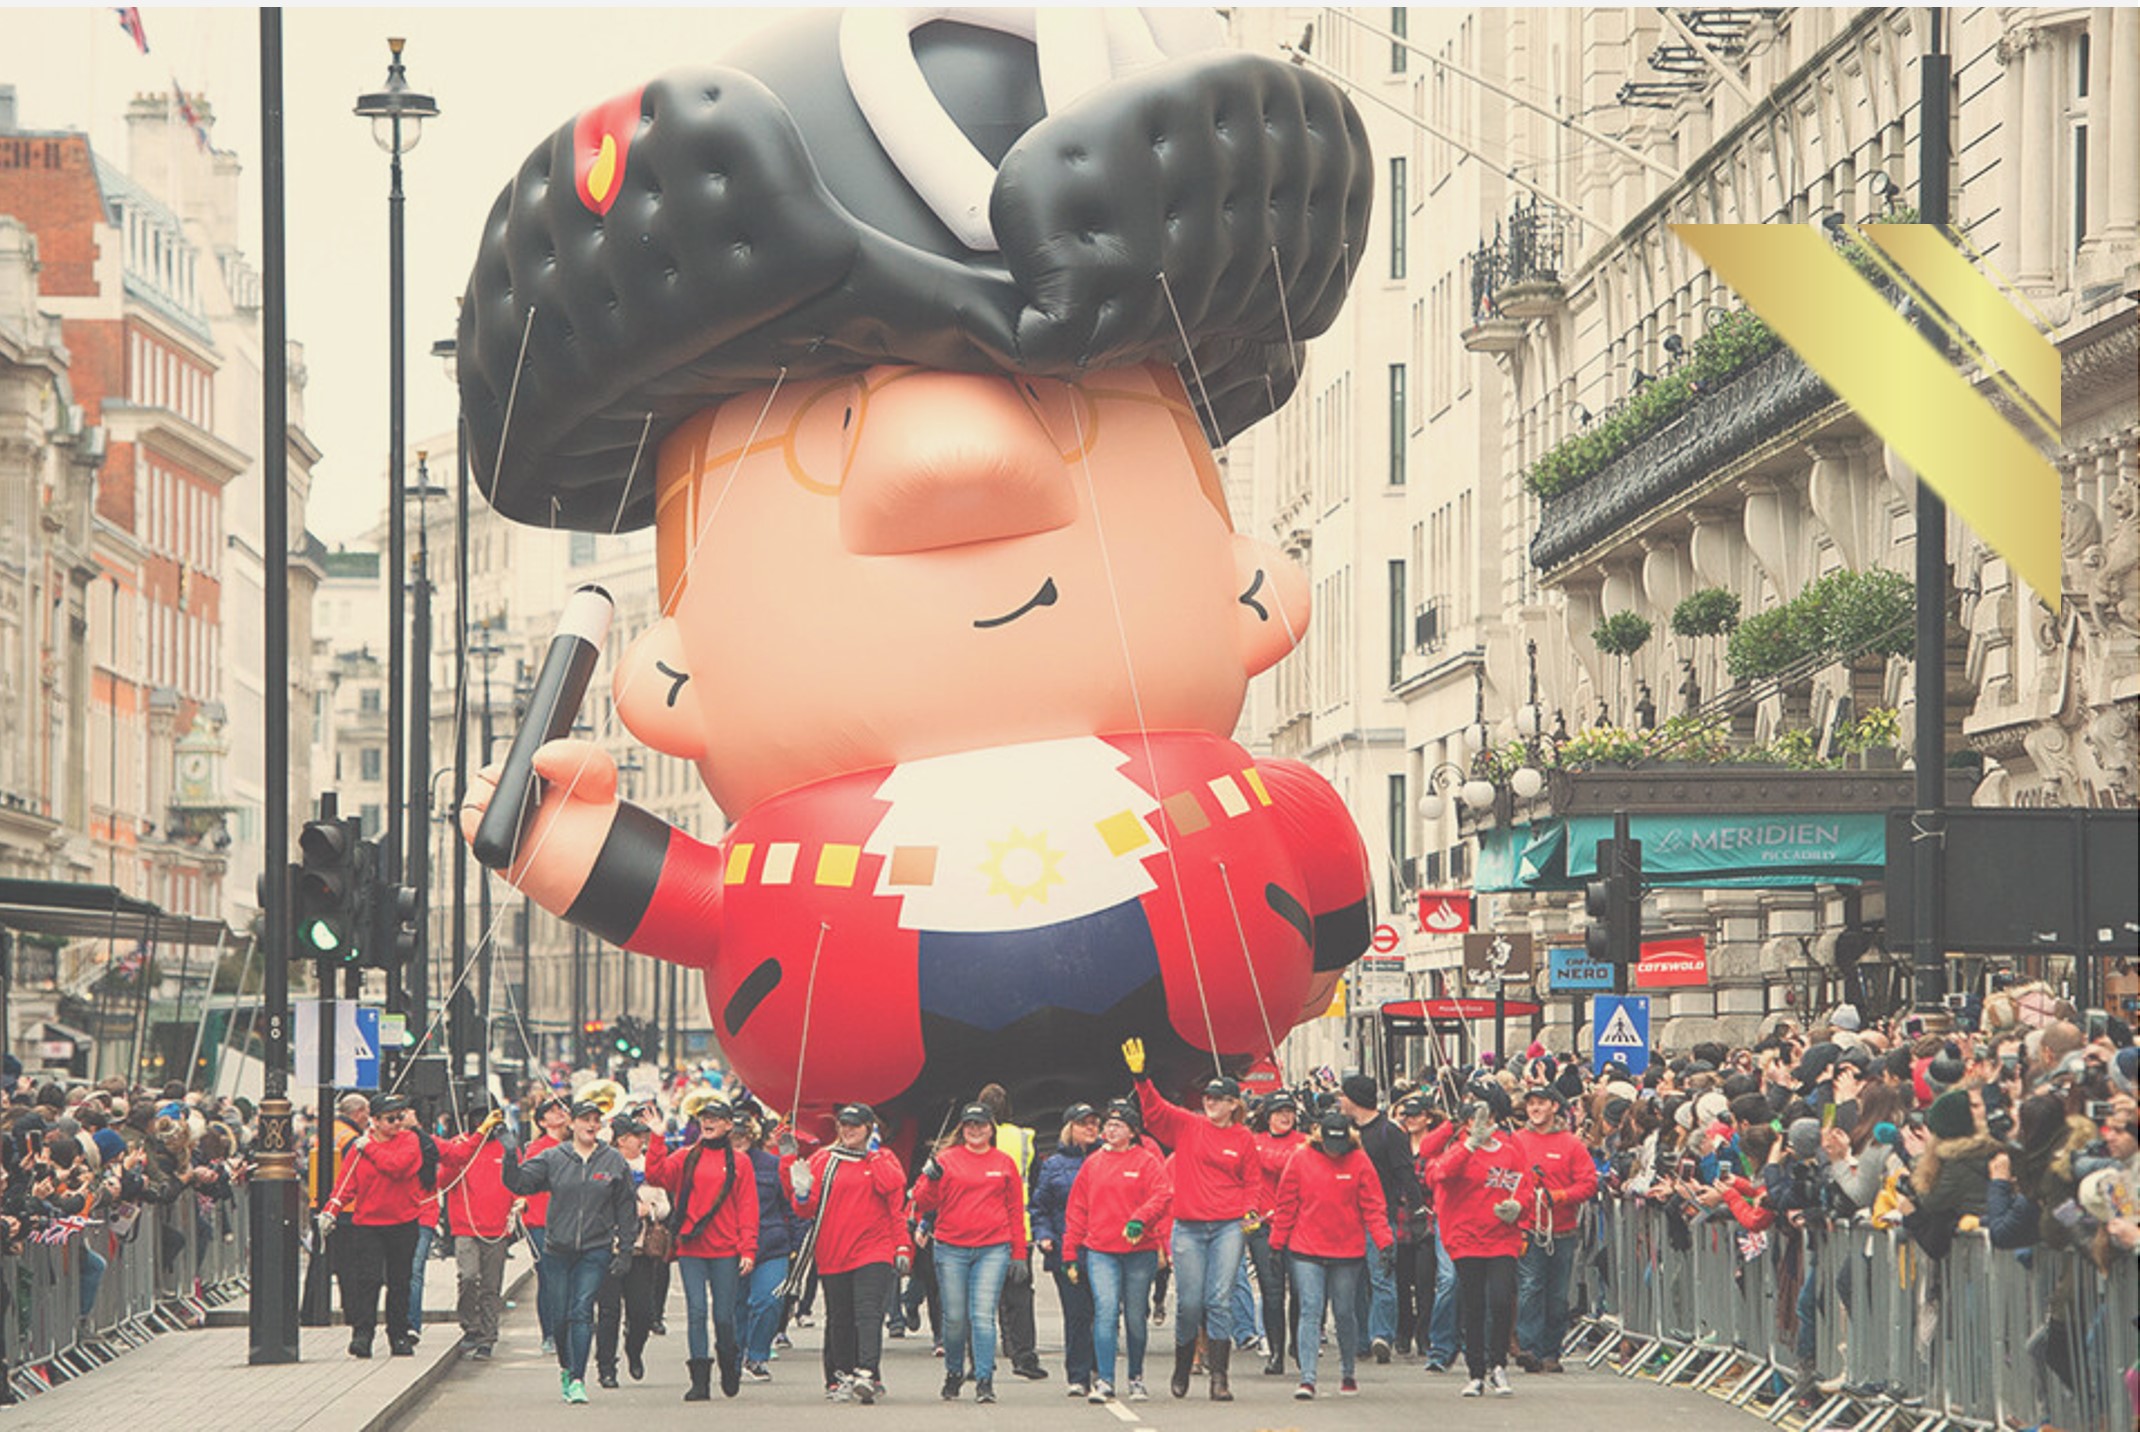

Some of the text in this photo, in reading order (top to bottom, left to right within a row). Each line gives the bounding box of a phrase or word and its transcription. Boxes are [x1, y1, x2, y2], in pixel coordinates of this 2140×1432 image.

[1690, 824, 1840, 850] MERIDIEN
[1557, 967, 1609, 981] NERO
[1637, 960, 1706, 974] COTSWOLD
